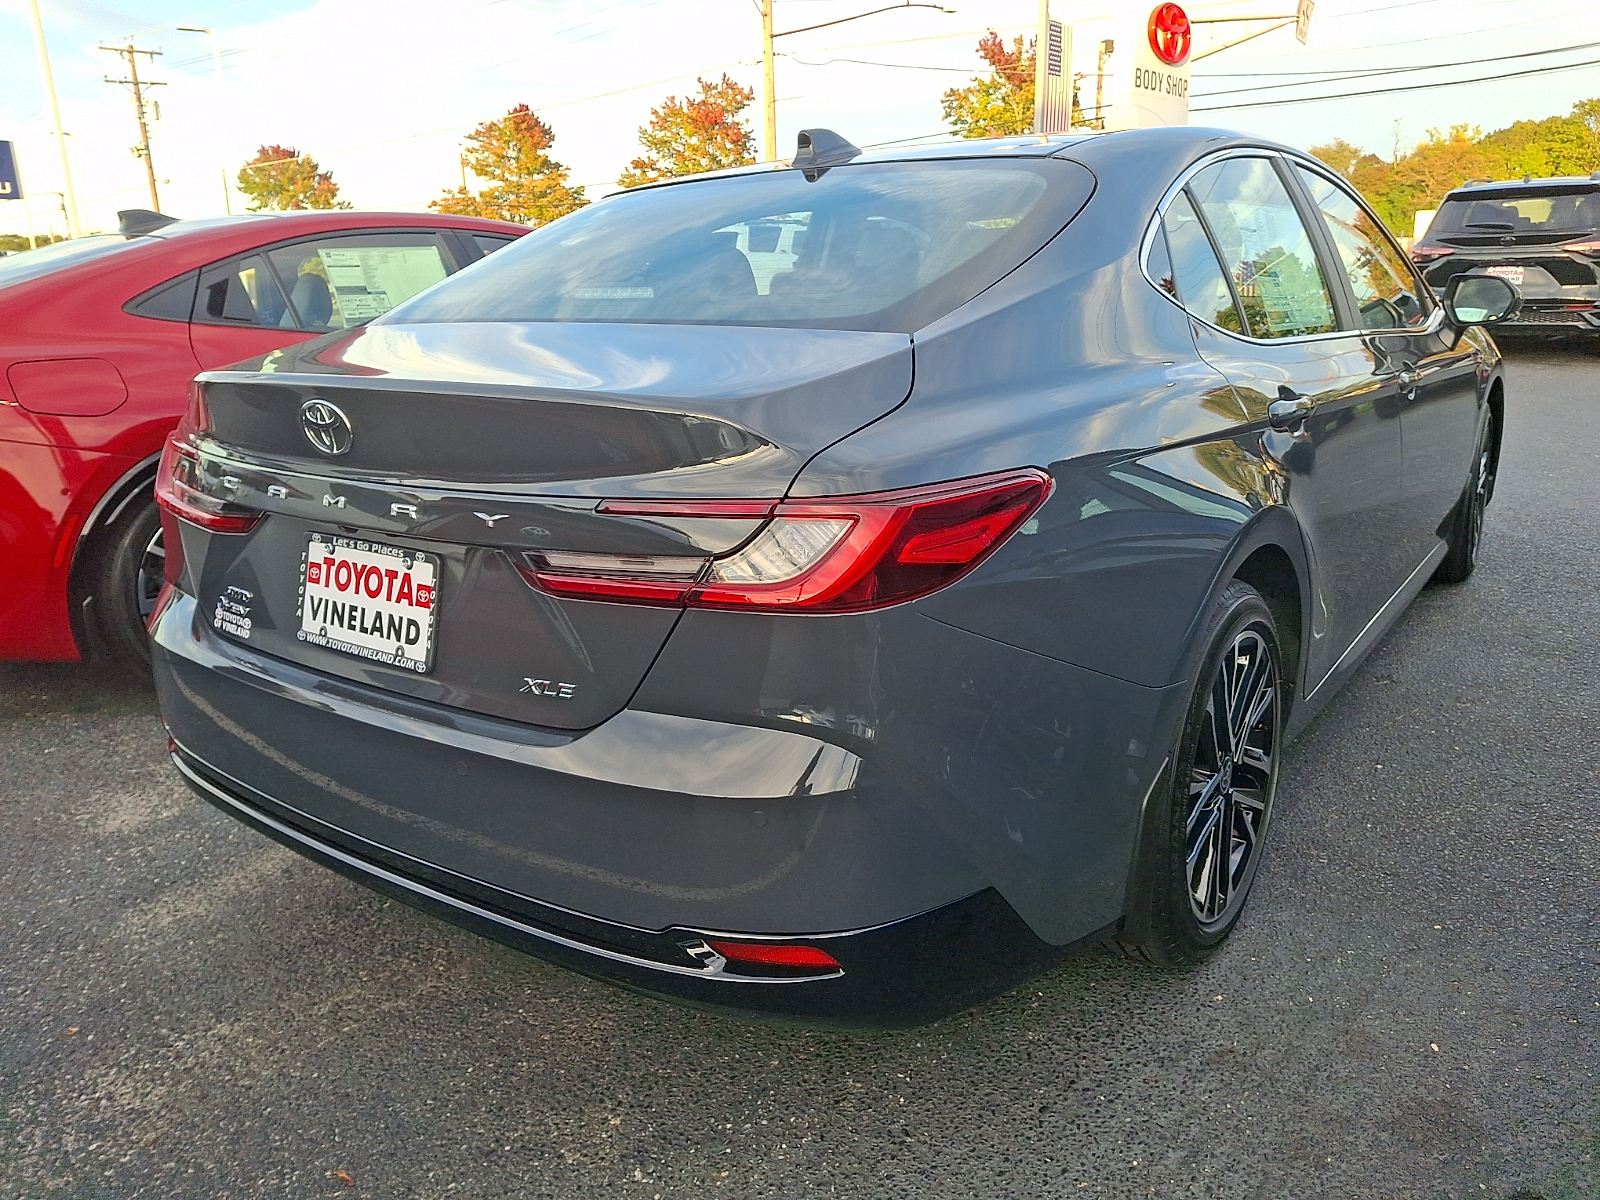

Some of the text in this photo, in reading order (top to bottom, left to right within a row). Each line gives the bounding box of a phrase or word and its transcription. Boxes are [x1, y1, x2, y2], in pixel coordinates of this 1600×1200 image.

[1135, 67, 1188, 98] BODY SHOP
[333, 537, 404, 557] Let's Go Places
[296, 552, 306, 617] TOYOTA
[323, 556, 414, 606] TOYOTA
[214, 618, 250, 638] OF VINELAND
[223, 611, 244, 627] TOYOTA
[309, 595, 421, 646] VINELAND
[426, 578, 436, 649] TOYOTA
[306, 633, 415, 670] WWW.TOYOTAVINELAND.COM
[519, 677, 577, 699] XLE
